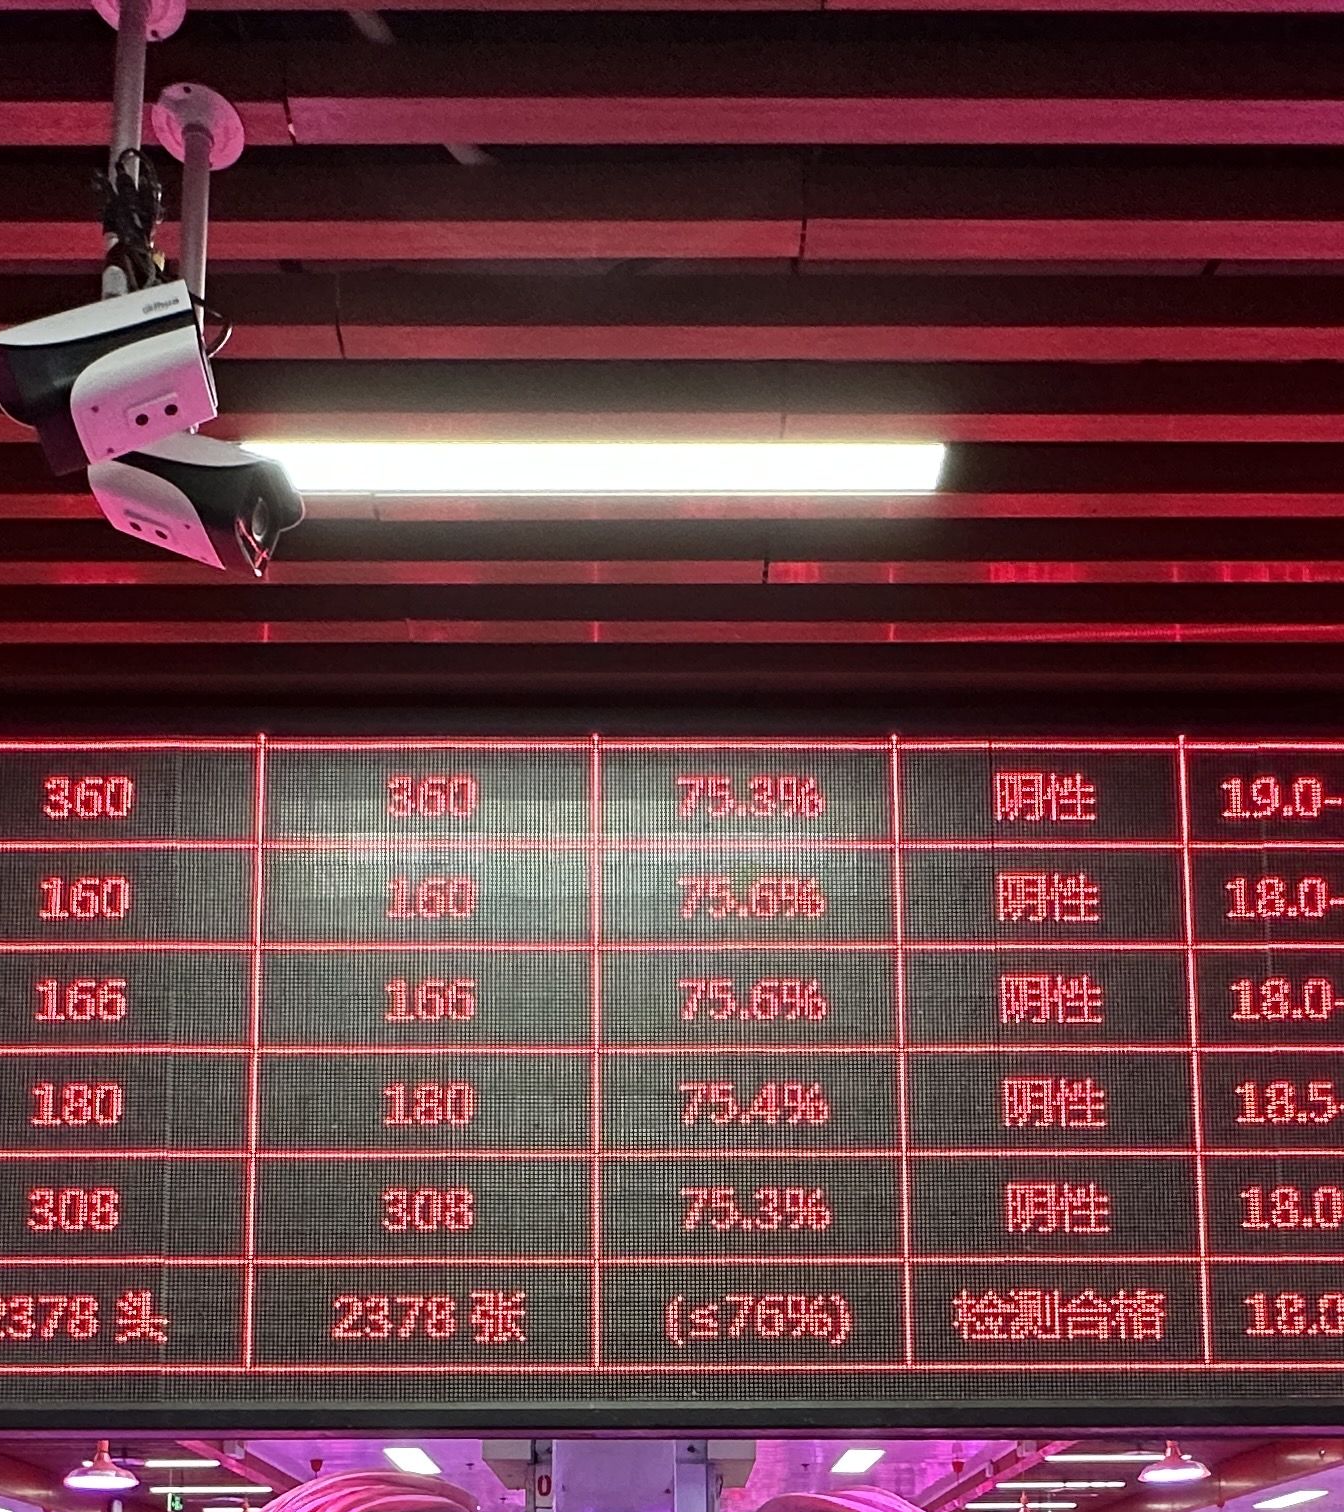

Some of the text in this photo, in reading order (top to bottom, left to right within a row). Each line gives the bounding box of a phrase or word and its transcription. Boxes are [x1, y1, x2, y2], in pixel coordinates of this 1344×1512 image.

[43, 774, 132, 819] 360
[387, 772, 479, 816] 360
[677, 773, 826, 818] 75.3%
[992, 768, 1095, 820] 阴性
[40, 874, 129, 922] 160
[386, 875, 477, 920] 160
[681, 874, 827, 920] 75.6%
[996, 869, 1100, 923] 阴性
[34, 976, 124, 1024] 166
[384, 976, 475, 1023] 166
[680, 976, 829, 1022] 75.6%
[999, 970, 1103, 1025] 阴性
[31, 1080, 120, 1128] 180
[383, 1080, 476, 1128] 180
[682, 1079, 831, 1124] 75.4%
[1002, 1074, 1105, 1129] 阴性
[27, 1186, 117, 1233] 308
[382, 1185, 473, 1233] 308
[683, 1185, 833, 1232] 75.3%
[1004, 1179, 1110, 1235] 阴性
[115, 1289, 164, 1344] 头
[330, 1289, 522, 1345] 2378 张
[955, 1287, 1167, 1342] 检测合格
